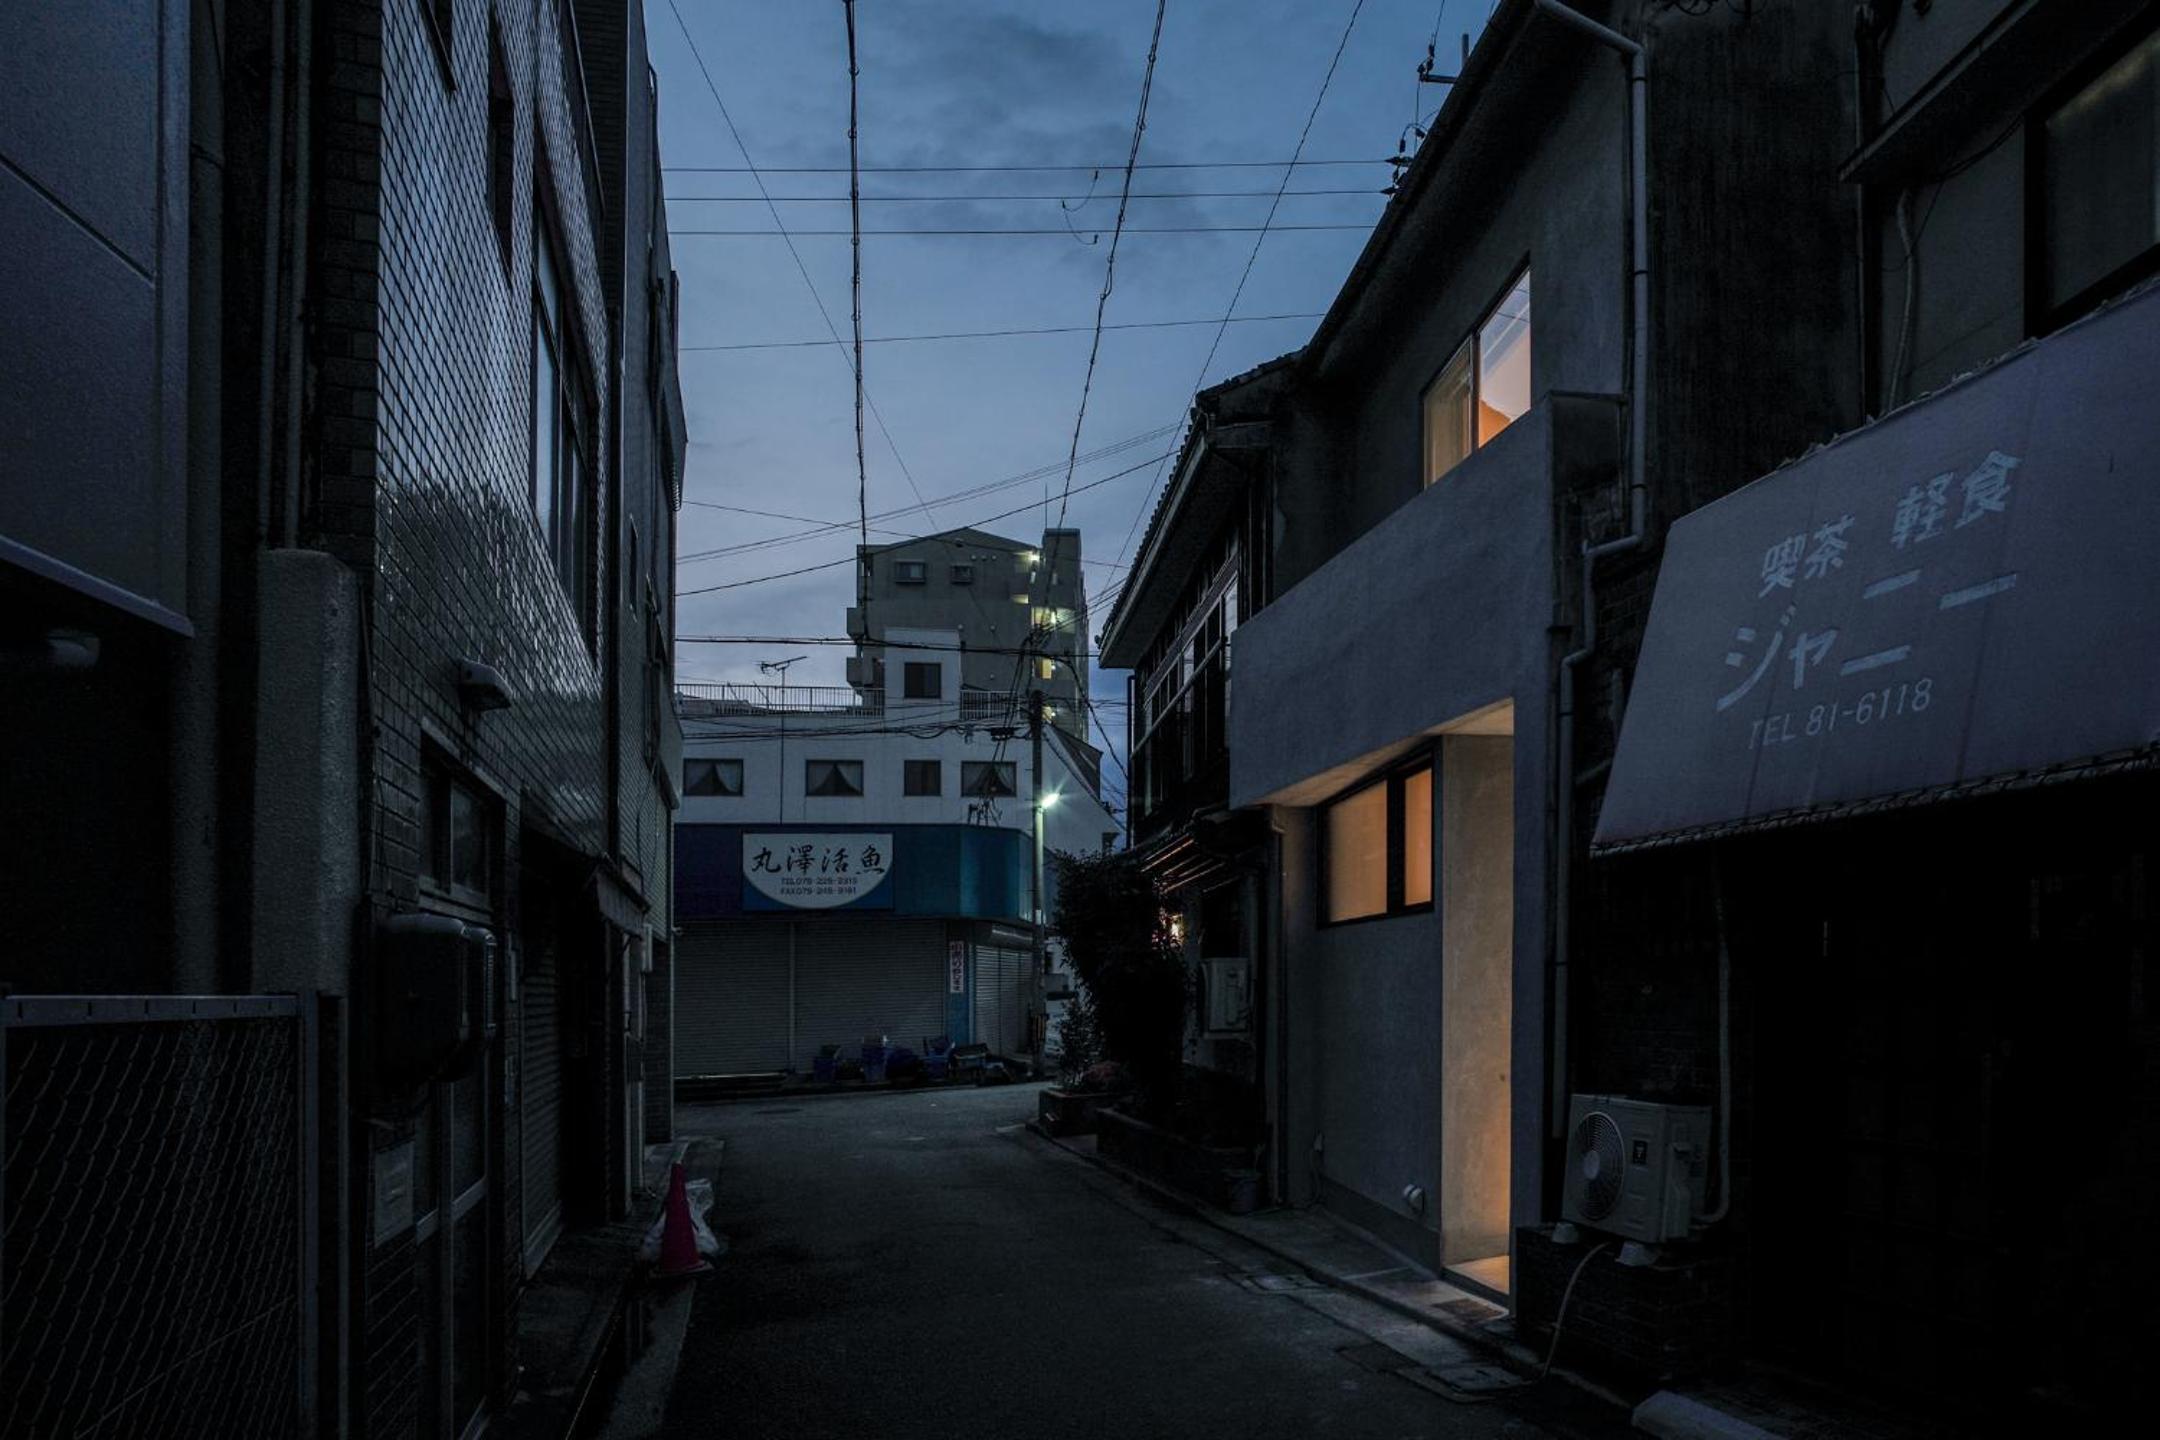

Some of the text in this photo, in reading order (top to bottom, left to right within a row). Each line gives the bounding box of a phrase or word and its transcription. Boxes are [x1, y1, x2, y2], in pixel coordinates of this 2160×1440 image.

[1758, 450, 2021, 599] 喫茶 軽食
[1717, 568, 2017, 712] ジャニー
[1749, 677, 1932, 749] TEL 81-6118
[751, 844, 885, 875] 丸澤活魚
